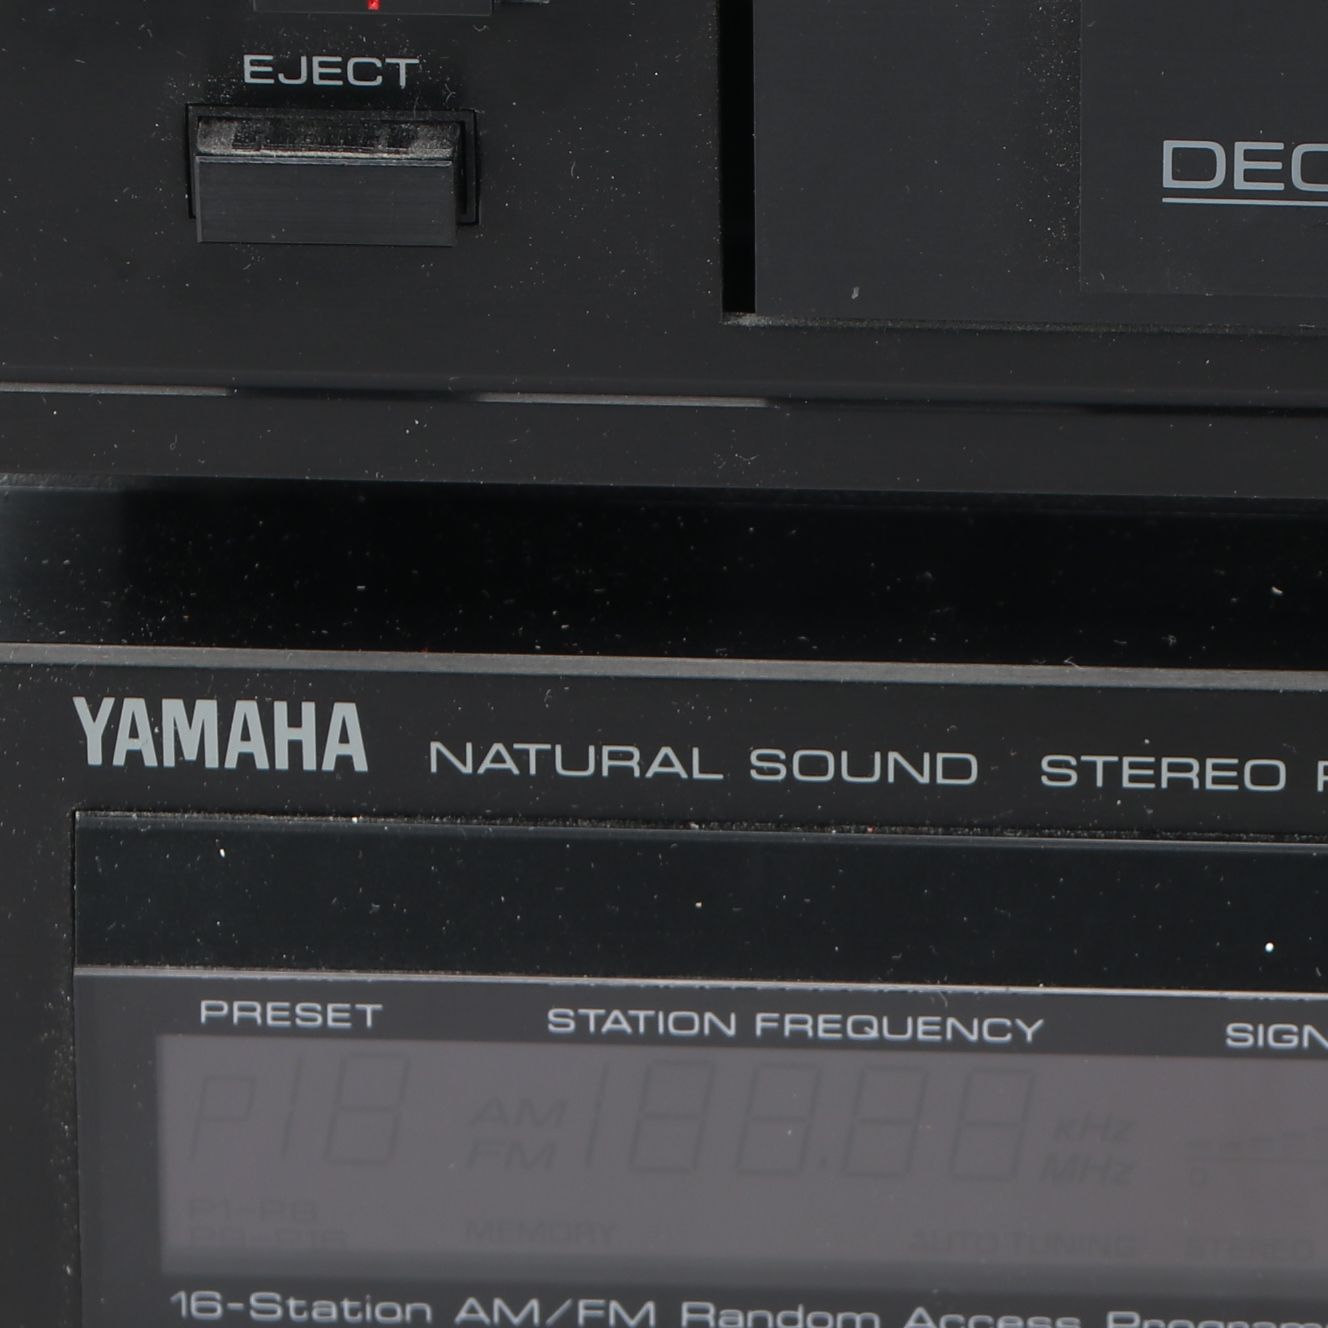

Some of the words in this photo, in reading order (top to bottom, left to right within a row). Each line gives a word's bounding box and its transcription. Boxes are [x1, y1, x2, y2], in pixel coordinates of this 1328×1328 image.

[243, 54, 420, 89] EJECT
[72, 696, 369, 773] YAMAHA
[429, 741, 724, 780] NATURAL
[749, 748, 978, 785] SOUND
[1040, 754, 1287, 792] STEREO
[200, 999, 383, 1028] PRESET
[547, 1007, 737, 1037] STATION
[755, 1012, 1044, 1043] FREQUENCY
[467, 1096, 568, 1129] AM
[465, 1140, 558, 1171] FM
[170, 1290, 433, 1324] 16-Station
[454, 1296, 656, 1328] AM/FM
